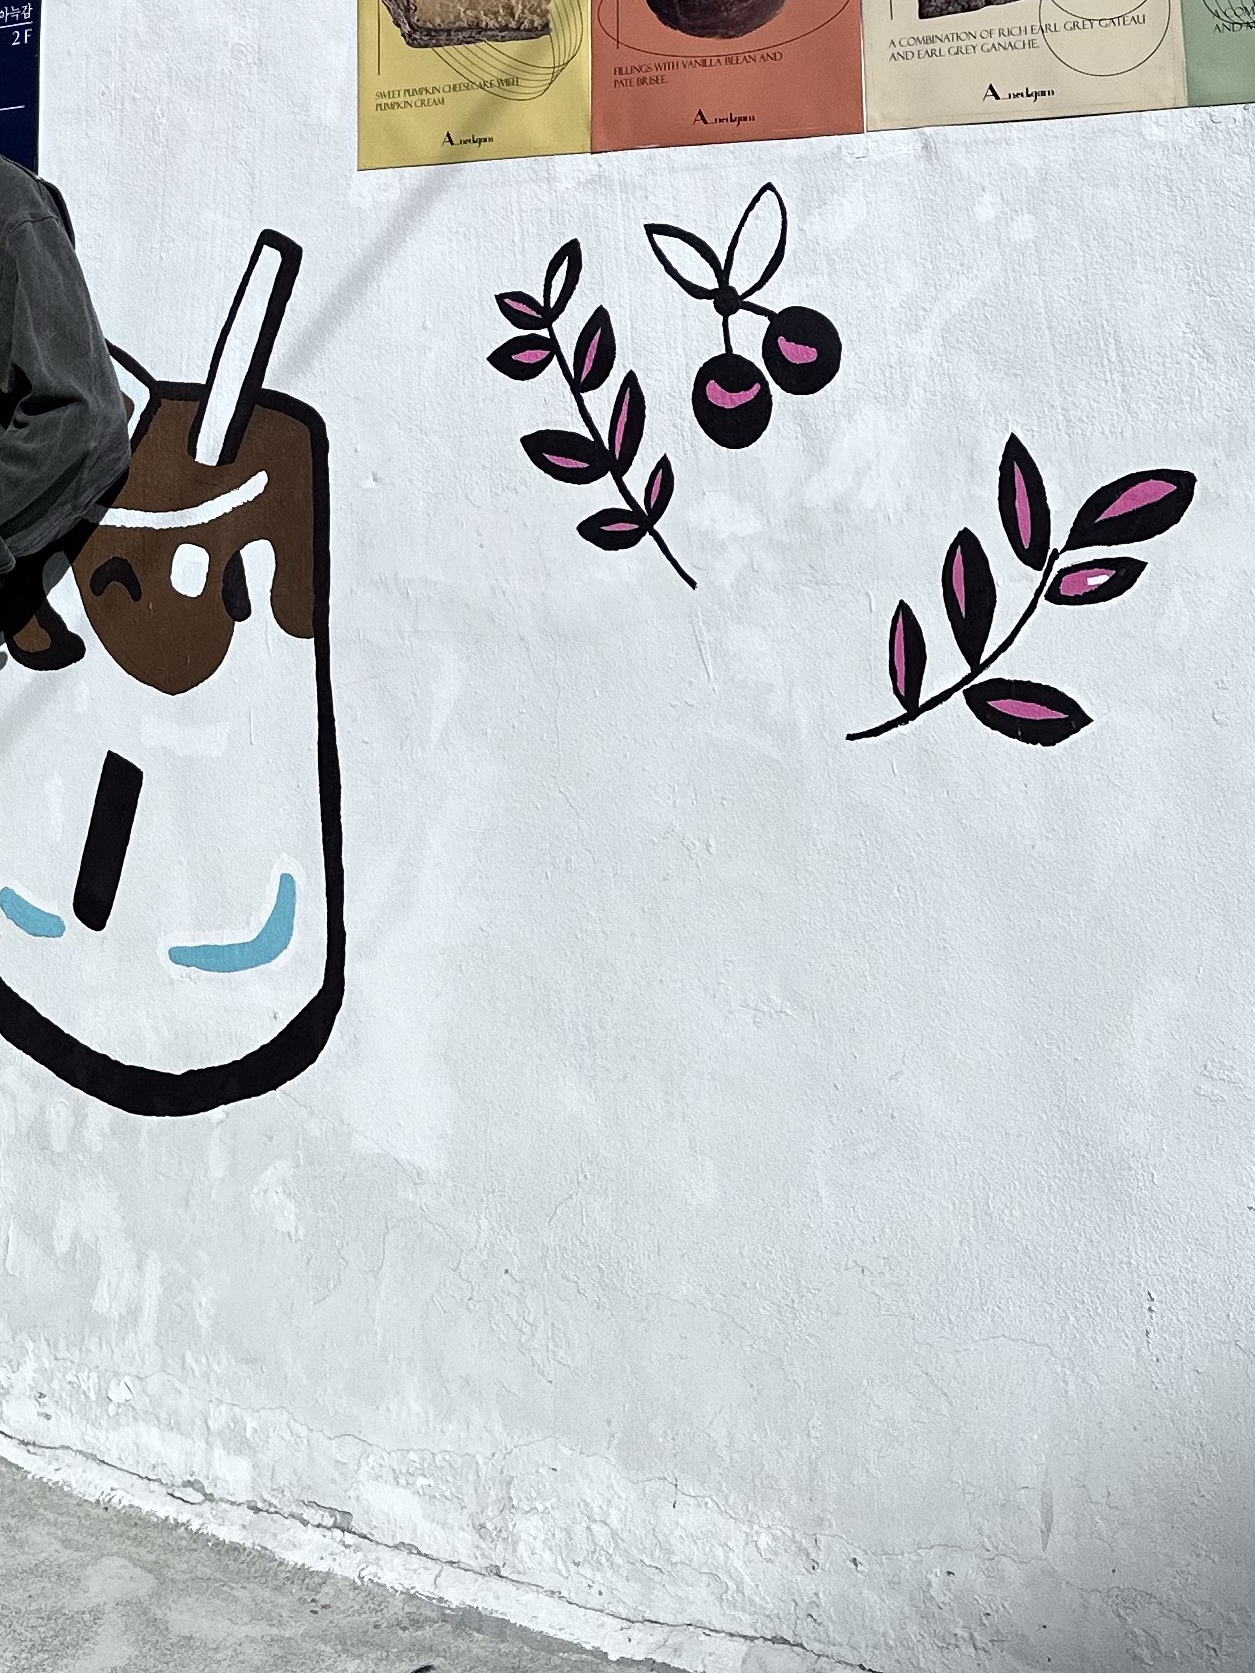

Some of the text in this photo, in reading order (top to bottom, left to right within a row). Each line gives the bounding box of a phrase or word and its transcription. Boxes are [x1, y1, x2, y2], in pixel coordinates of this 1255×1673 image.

[888, 14, 1147, 49] A COMBINATION OF RICH EARL GREY GATEAU
[888, 50, 915, 62] AND
[917, 47, 945, 60] EARL
[948, 44, 977, 57] GREY
[613, 63, 653, 76] FILLINGS
[654, 60, 680, 73] WITH
[682, 56, 723, 69] VANILLA
[759, 51, 784, 62] AND
[613, 77, 635, 89] PATE
[403, 85, 441, 98] PUMPKIN
[414, 97, 445, 109] CREAM
